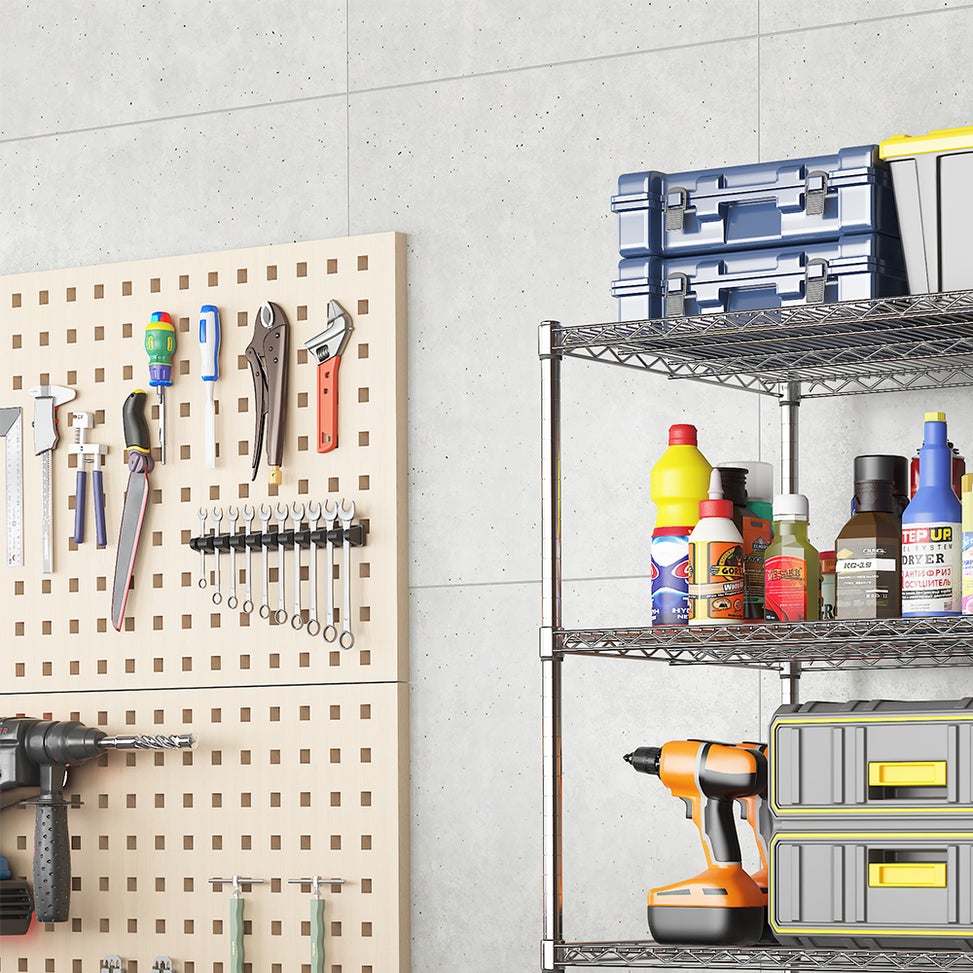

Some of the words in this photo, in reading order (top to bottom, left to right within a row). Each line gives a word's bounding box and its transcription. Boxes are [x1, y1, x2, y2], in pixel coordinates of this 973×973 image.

[902, 530, 928, 543] TEP
[931, 527, 952, 542] UP
[902, 552, 945, 565] DRYER
[904, 568, 952, 578] АНТИФРИЗ
[904, 578, 951, 588] ОСУШИТЕЛЬ
